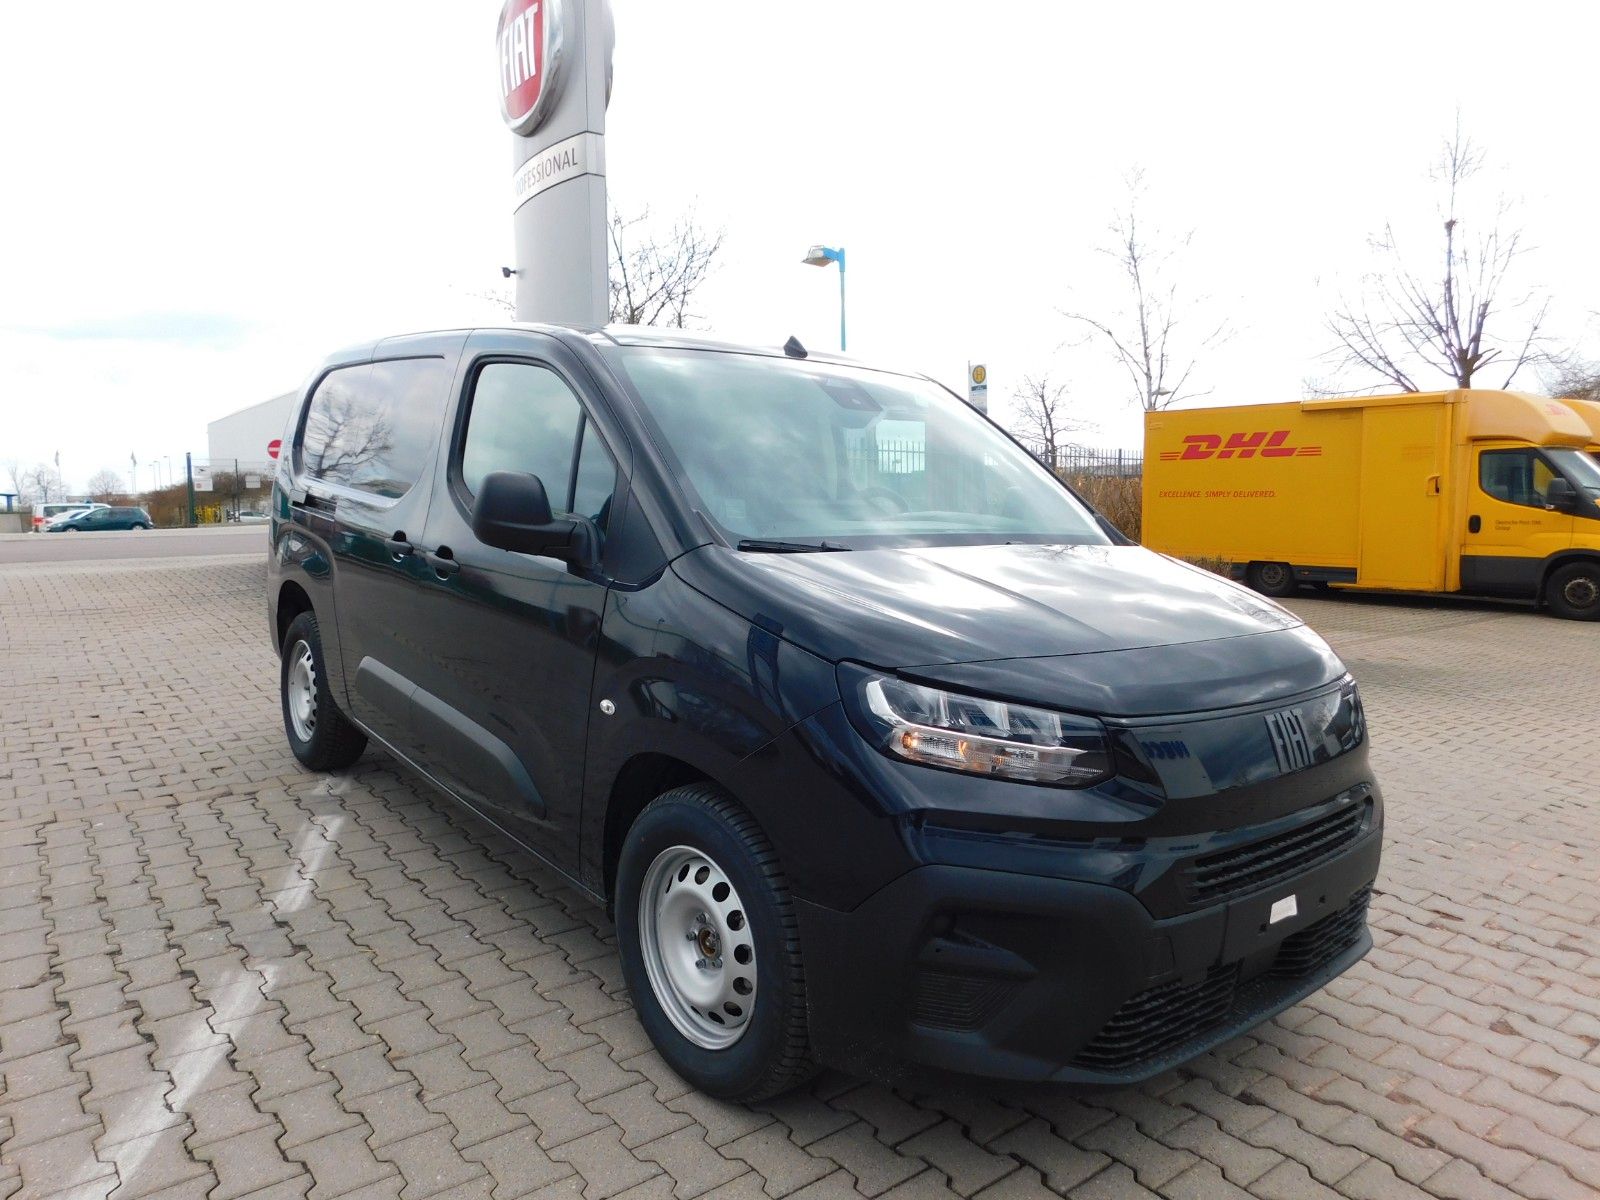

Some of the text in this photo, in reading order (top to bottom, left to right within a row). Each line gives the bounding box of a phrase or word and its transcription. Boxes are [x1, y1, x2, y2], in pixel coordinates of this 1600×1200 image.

[502, 2, 538, 97] FIAT
[515, 148, 578, 195] OFESSIONAL
[1180, 430, 1298, 460] DHL
[1204, 490, 1231, 498] SIMPLY
[1264, 708, 1315, 773] FIAT
